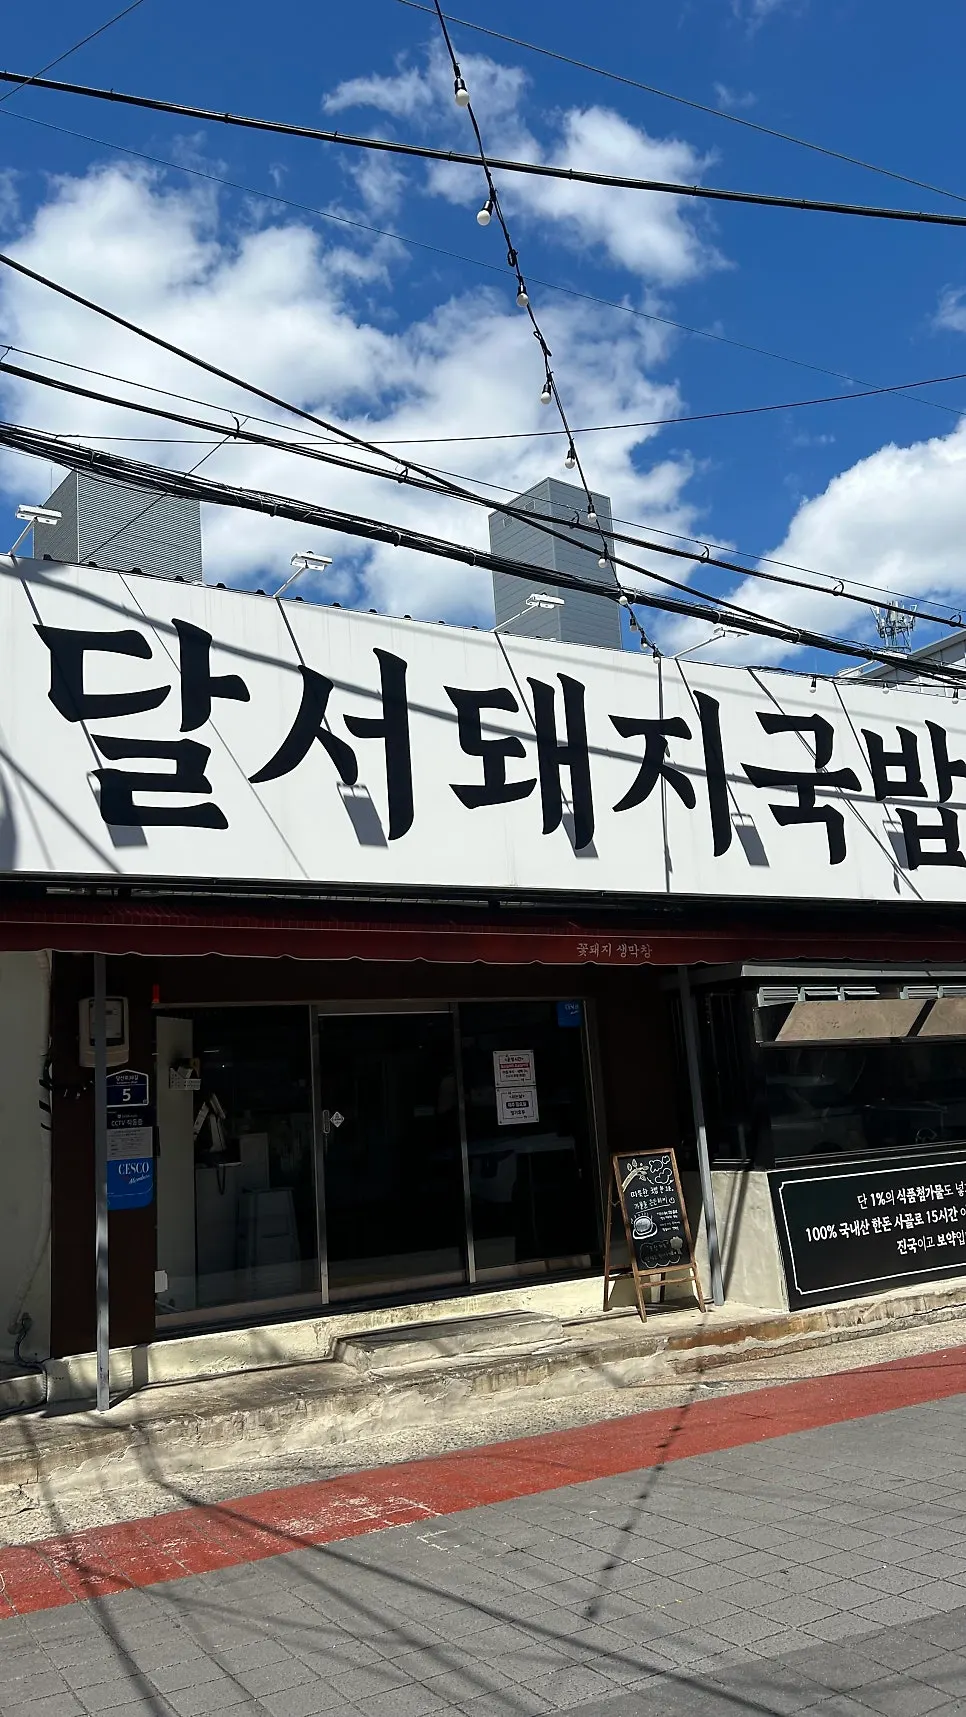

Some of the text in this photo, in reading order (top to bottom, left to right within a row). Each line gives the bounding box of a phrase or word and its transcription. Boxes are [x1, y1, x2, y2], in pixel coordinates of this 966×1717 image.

[33, 618, 966, 870] 달서돼지국밥
[576, 942, 653, 959] 꽃돼지 생막창
[122, 1088, 132, 1102] 5
[118, 1161, 150, 1175] CESCO
[857, 1194, 868, 1210] 단
[870, 1189, 895, 1207] 1%의
[896, 1184, 954, 1205] 식품첨가물도
[805, 1223, 838, 1242] 100%
[838, 1218, 870, 1239] 국내산
[871, 1215, 893, 1234] 한돈
[893, 1212, 925, 1231] 사골로
[926, 1206, 959, 1224] 15시간
[896, 1229, 966, 1255] 진국이고 보약입
